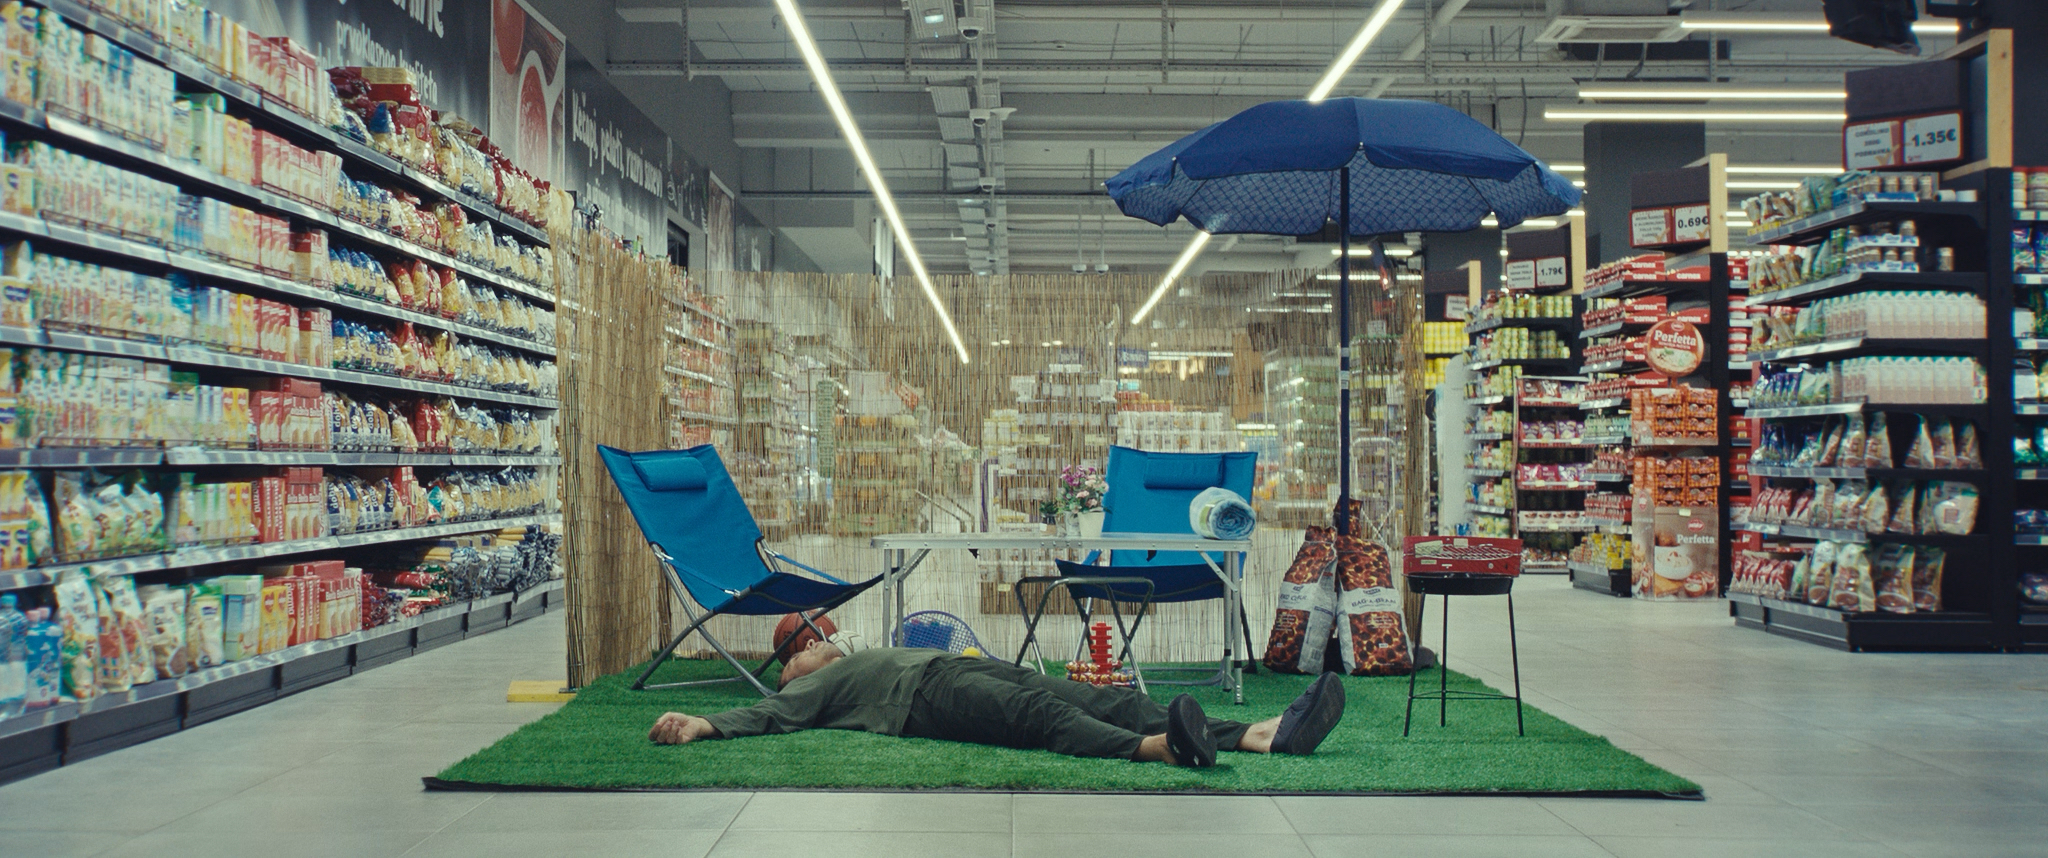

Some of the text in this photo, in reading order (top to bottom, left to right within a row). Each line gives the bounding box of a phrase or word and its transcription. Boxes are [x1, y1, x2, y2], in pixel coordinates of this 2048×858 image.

[1911, 128, 1957, 147] 1.35€
[1677, 216, 1709, 228] 0.69€
[1541, 266, 1563, 276] 1.79€
[1653, 329, 1696, 346] Perfetta
[1676, 534, 1715, 544] Perfetta
